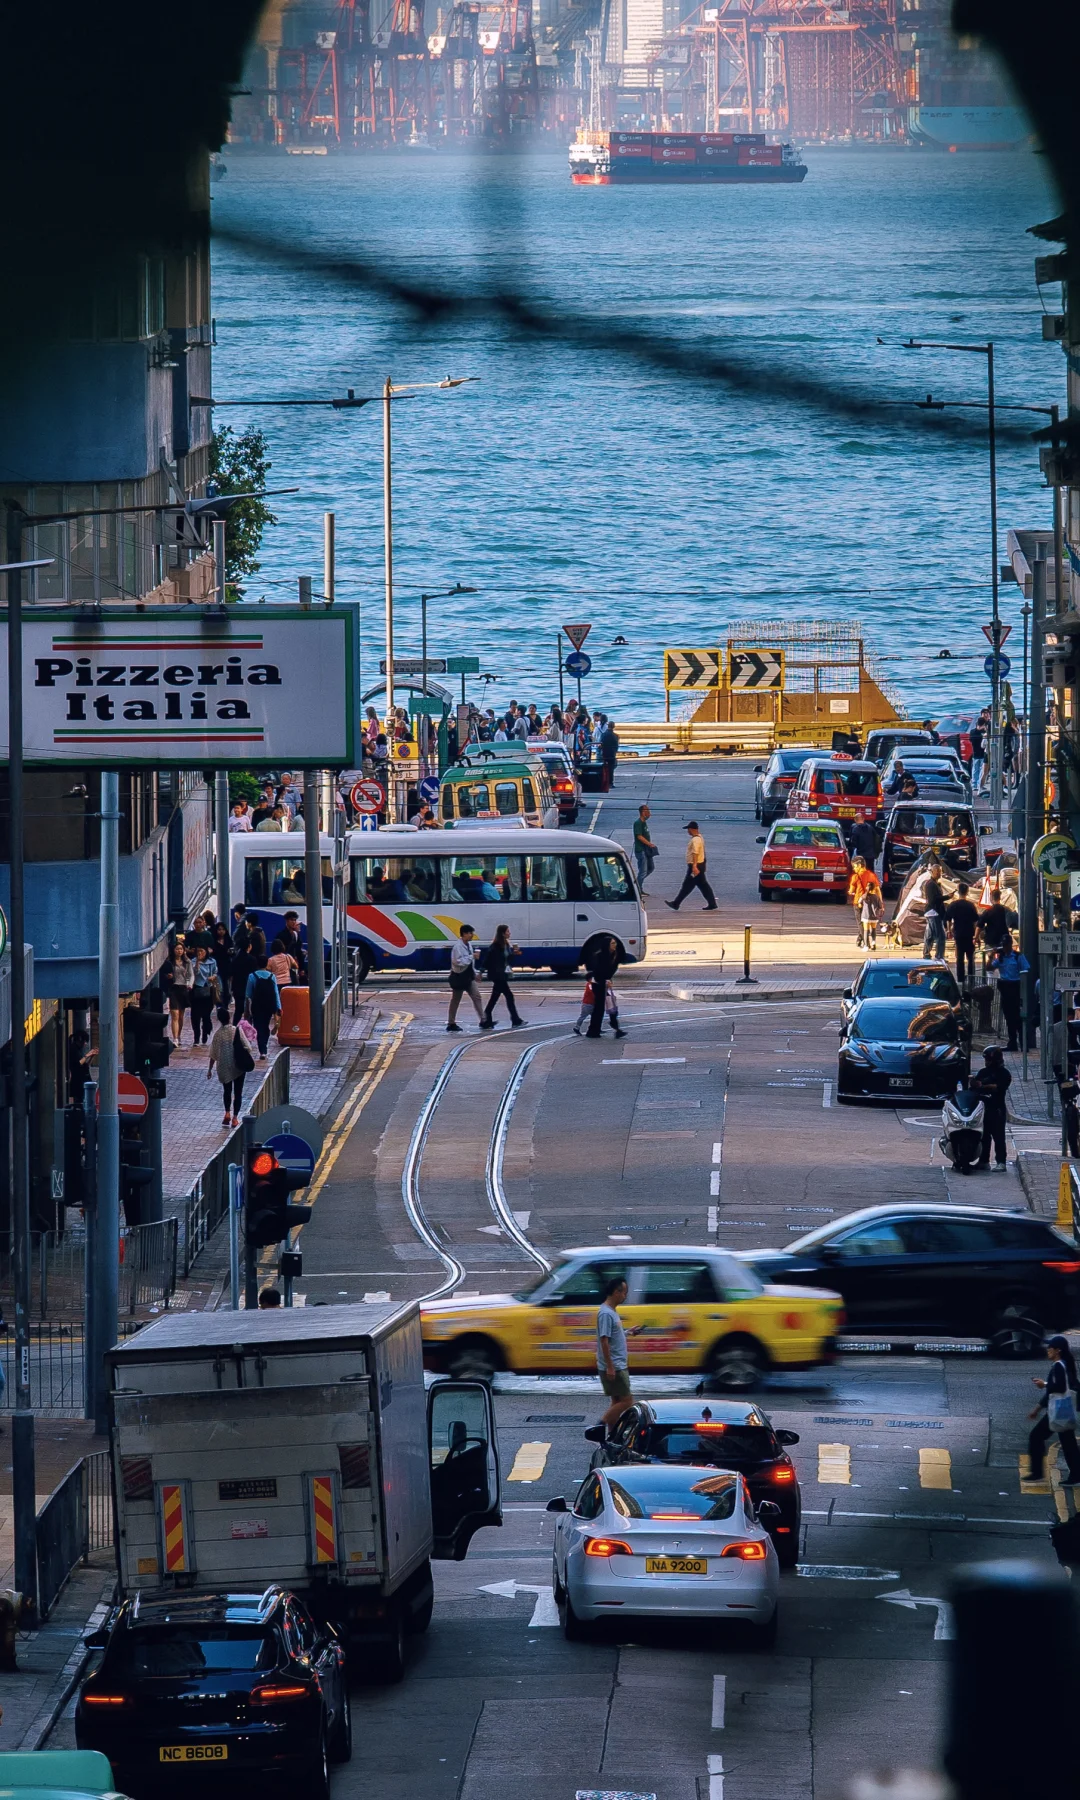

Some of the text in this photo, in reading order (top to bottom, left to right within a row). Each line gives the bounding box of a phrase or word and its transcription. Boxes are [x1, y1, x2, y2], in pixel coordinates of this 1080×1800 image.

[34, 656, 282, 686] Pizzeria
[66, 692, 251, 720] Italia
[652, 1561, 701, 1571] NA 9200
[163, 1746, 223, 1760] NC 8608
